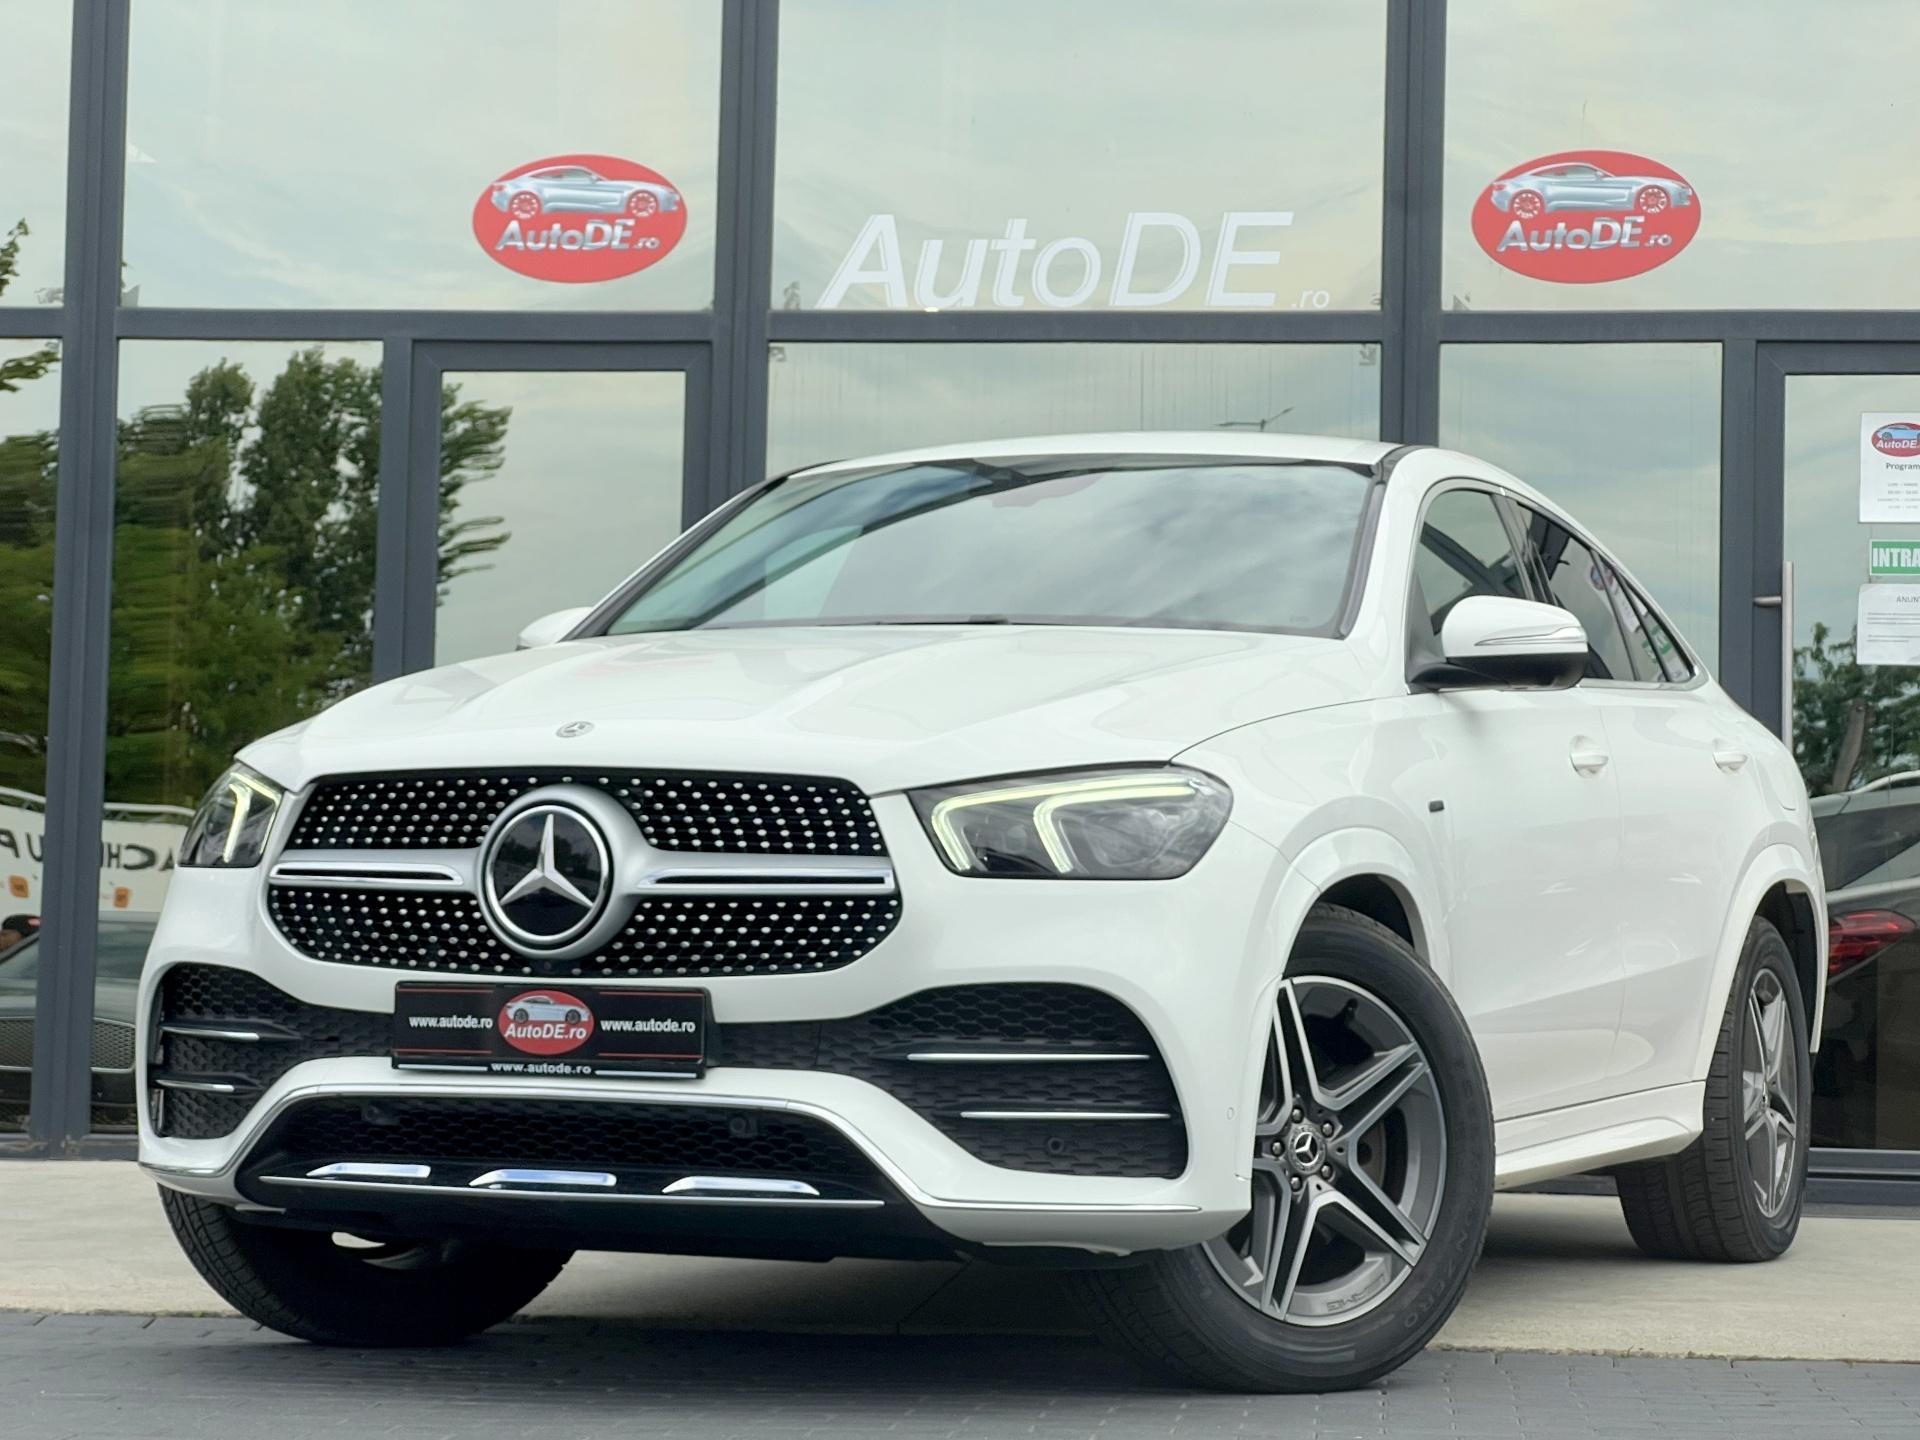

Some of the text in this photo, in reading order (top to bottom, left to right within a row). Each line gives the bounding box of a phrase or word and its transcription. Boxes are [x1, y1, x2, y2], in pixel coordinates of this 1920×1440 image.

[1872, 547, 1920, 568] INTRA
[1896, 595, 1920, 603] ANUN
[409, 1015, 494, 1029] www.autode.ro
[600, 1018, 696, 1033] www.autode.ro
[504, 1022, 587, 1040] AutoDE.ro
[490, 1062, 592, 1075] www.autode.ro
